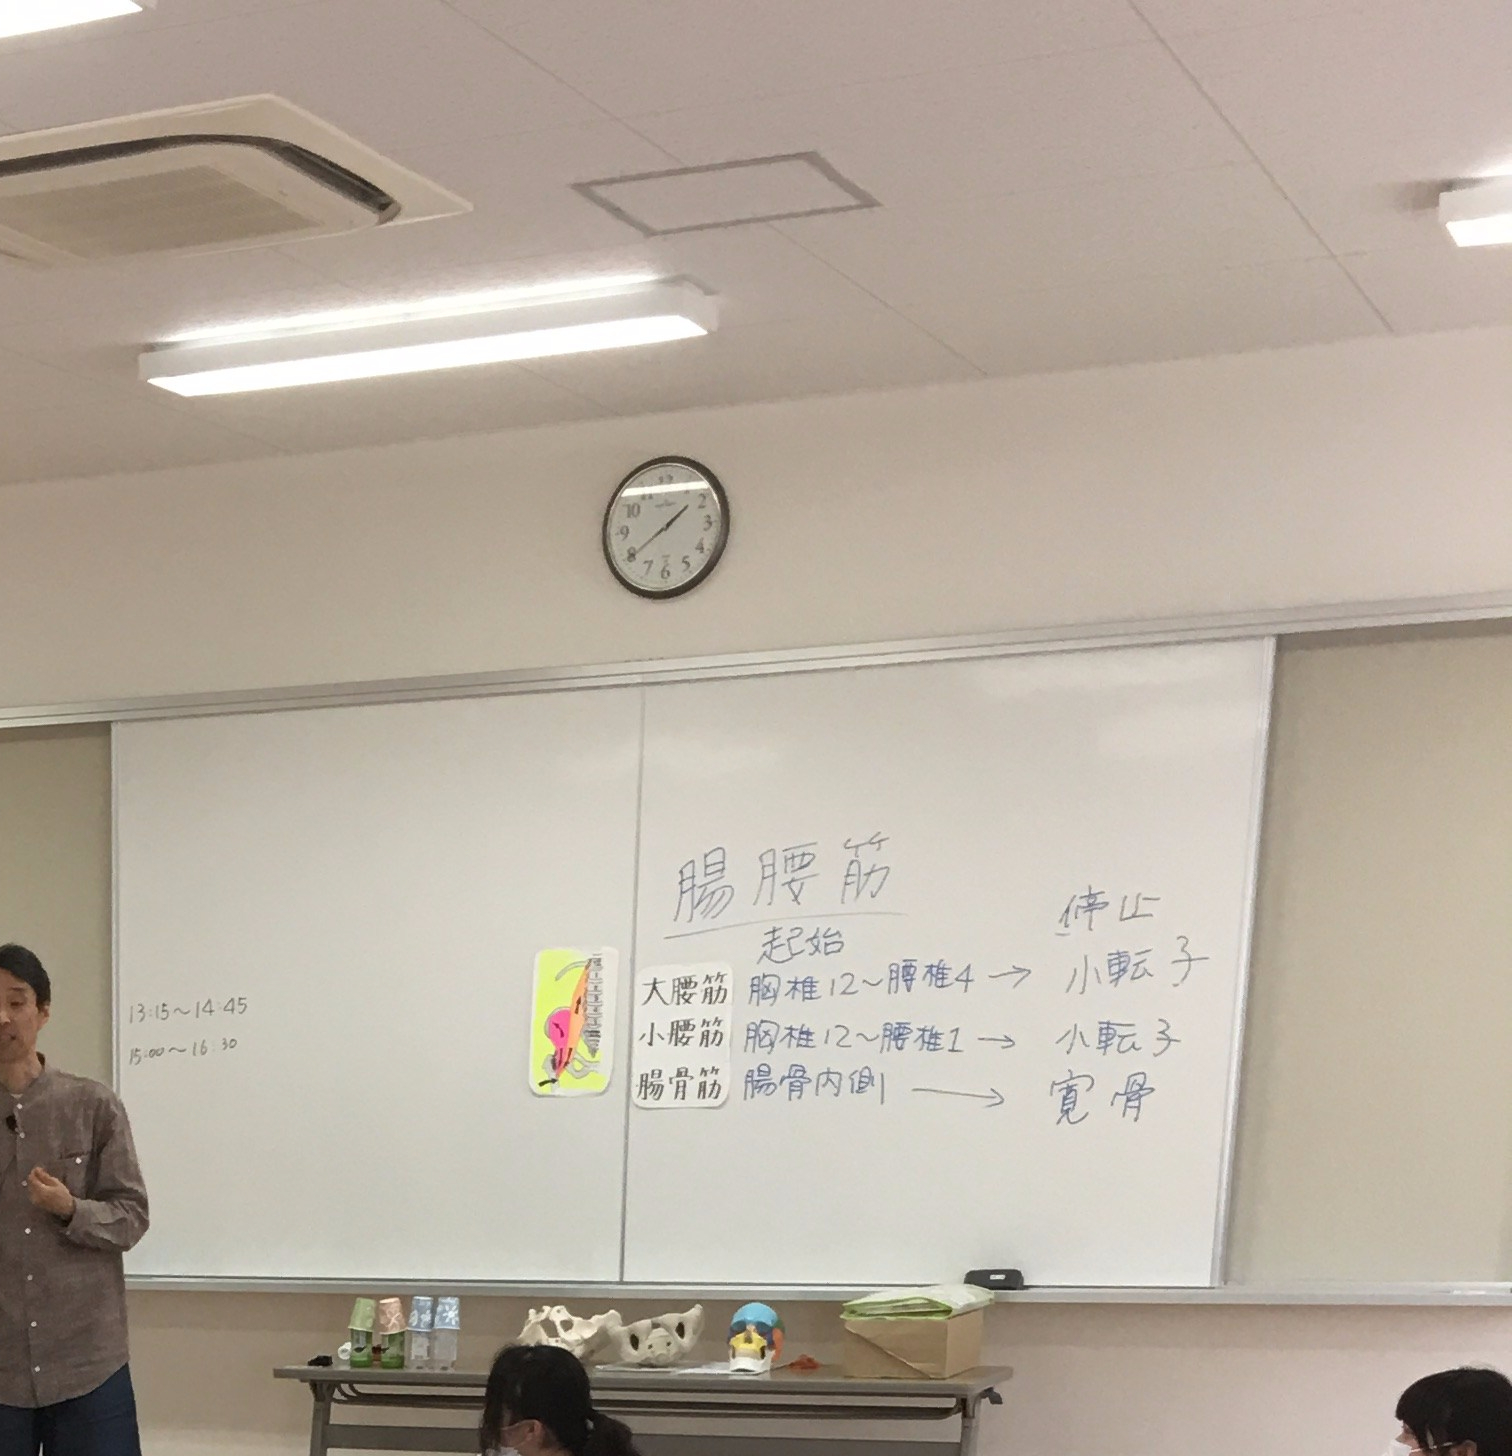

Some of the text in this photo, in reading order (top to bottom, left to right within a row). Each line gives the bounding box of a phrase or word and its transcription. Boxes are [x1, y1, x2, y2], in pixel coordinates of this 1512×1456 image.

[673, 831, 890, 923] 腸腰筋
[1058, 885, 1161, 931] 停止
[756, 926, 844, 964] 起始
[1065, 935, 1210, 995] 小転子
[641, 971, 728, 1006] 大腰筋
[639, 1015, 724, 1048] 小腰筋
[1055, 1018, 1182, 1058] 小転子
[636, 1065, 722, 1101] 腸骨筋
[744, 1062, 886, 1104] 腸骨内側
